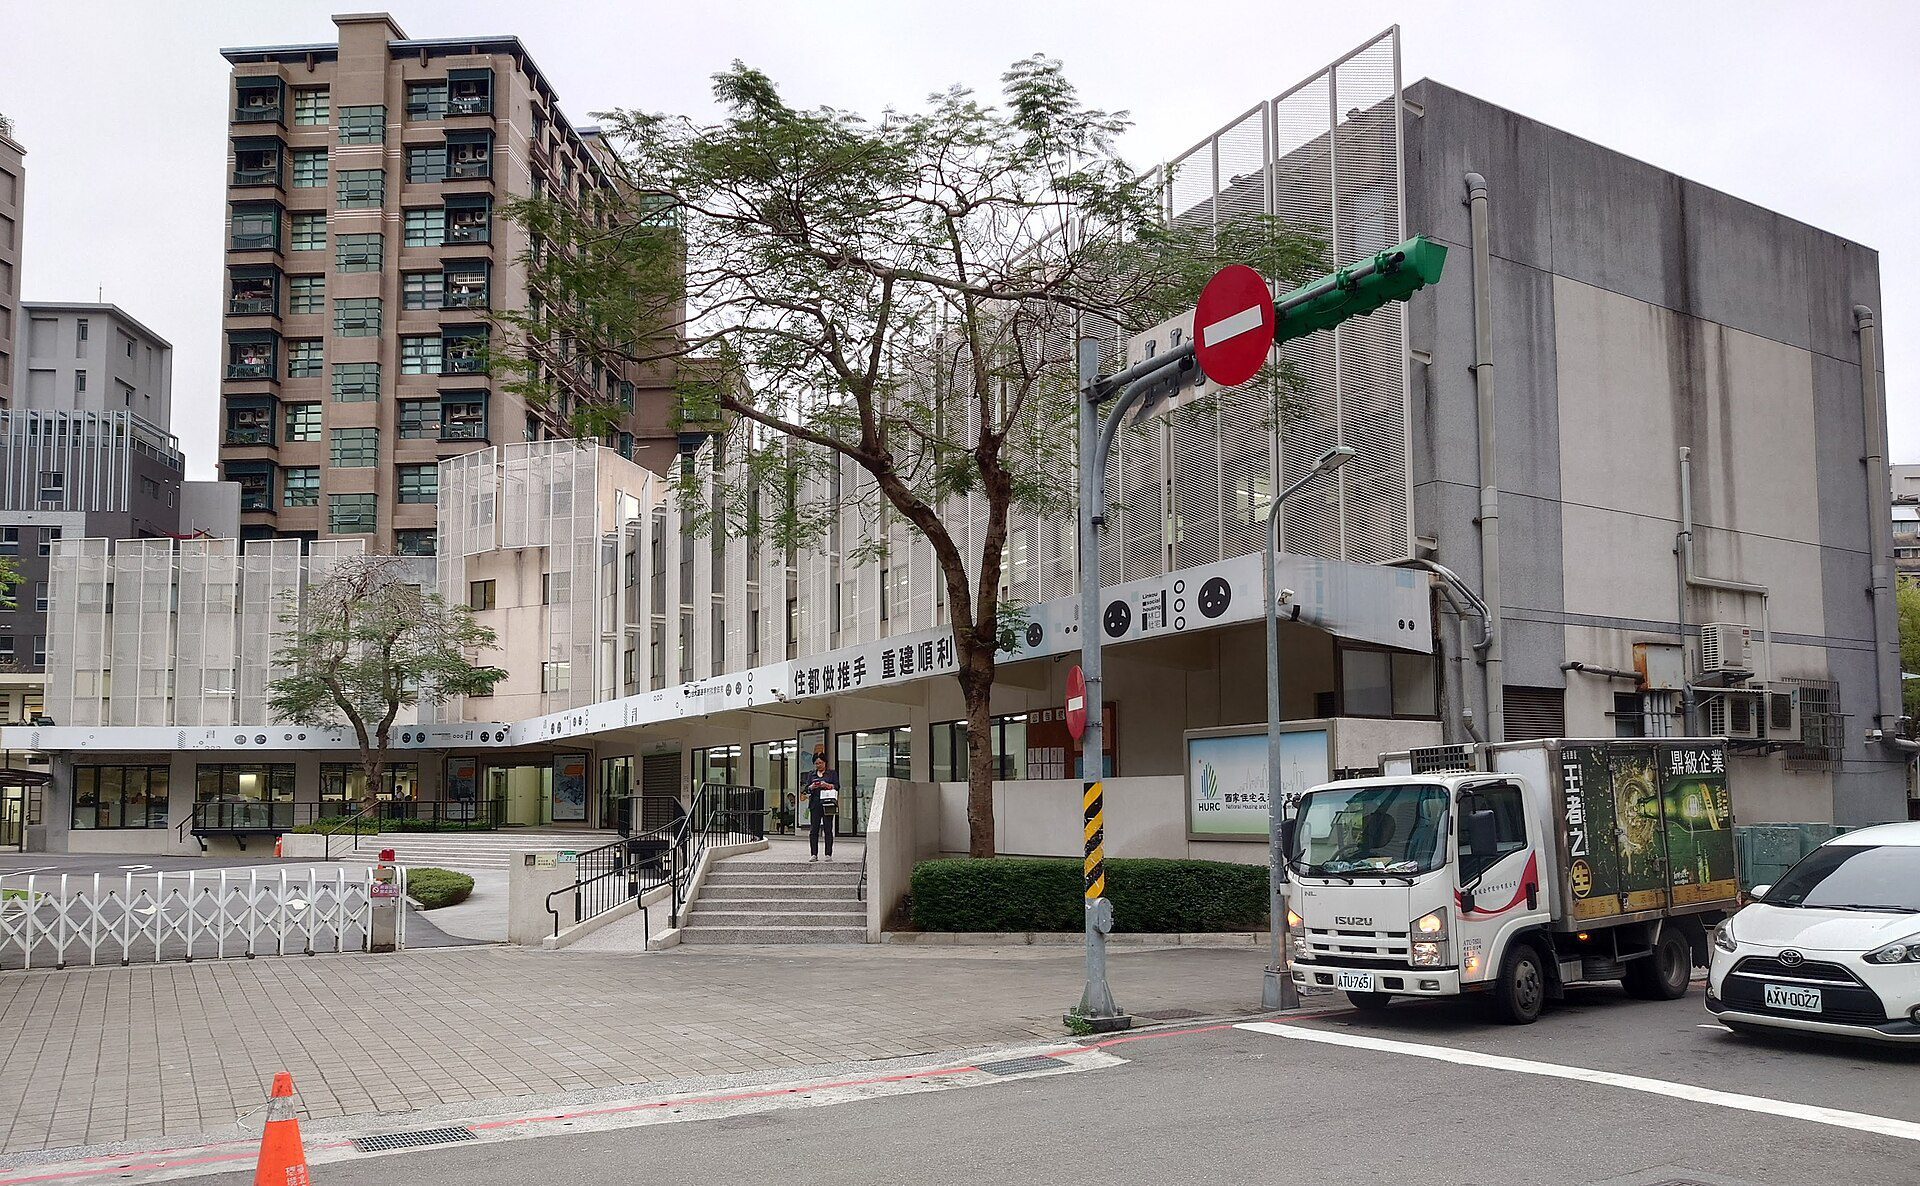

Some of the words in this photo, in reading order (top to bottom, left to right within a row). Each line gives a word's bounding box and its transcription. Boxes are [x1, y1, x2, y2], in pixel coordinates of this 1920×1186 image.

[794, 656, 867, 696] 住都做推手
[881, 635, 953, 680] 重建順利
[1671, 749, 1724, 775] 鼎級企業
[1198, 803, 1220, 811] HURC
[1563, 764, 1586, 857] 王者之
[1572, 865, 1591, 892] 生
[1335, 916, 1373, 926] ISUZU
[1338, 976, 1372, 989] ATU-7651
[1767, 990, 1820, 1008] AXV-0027
